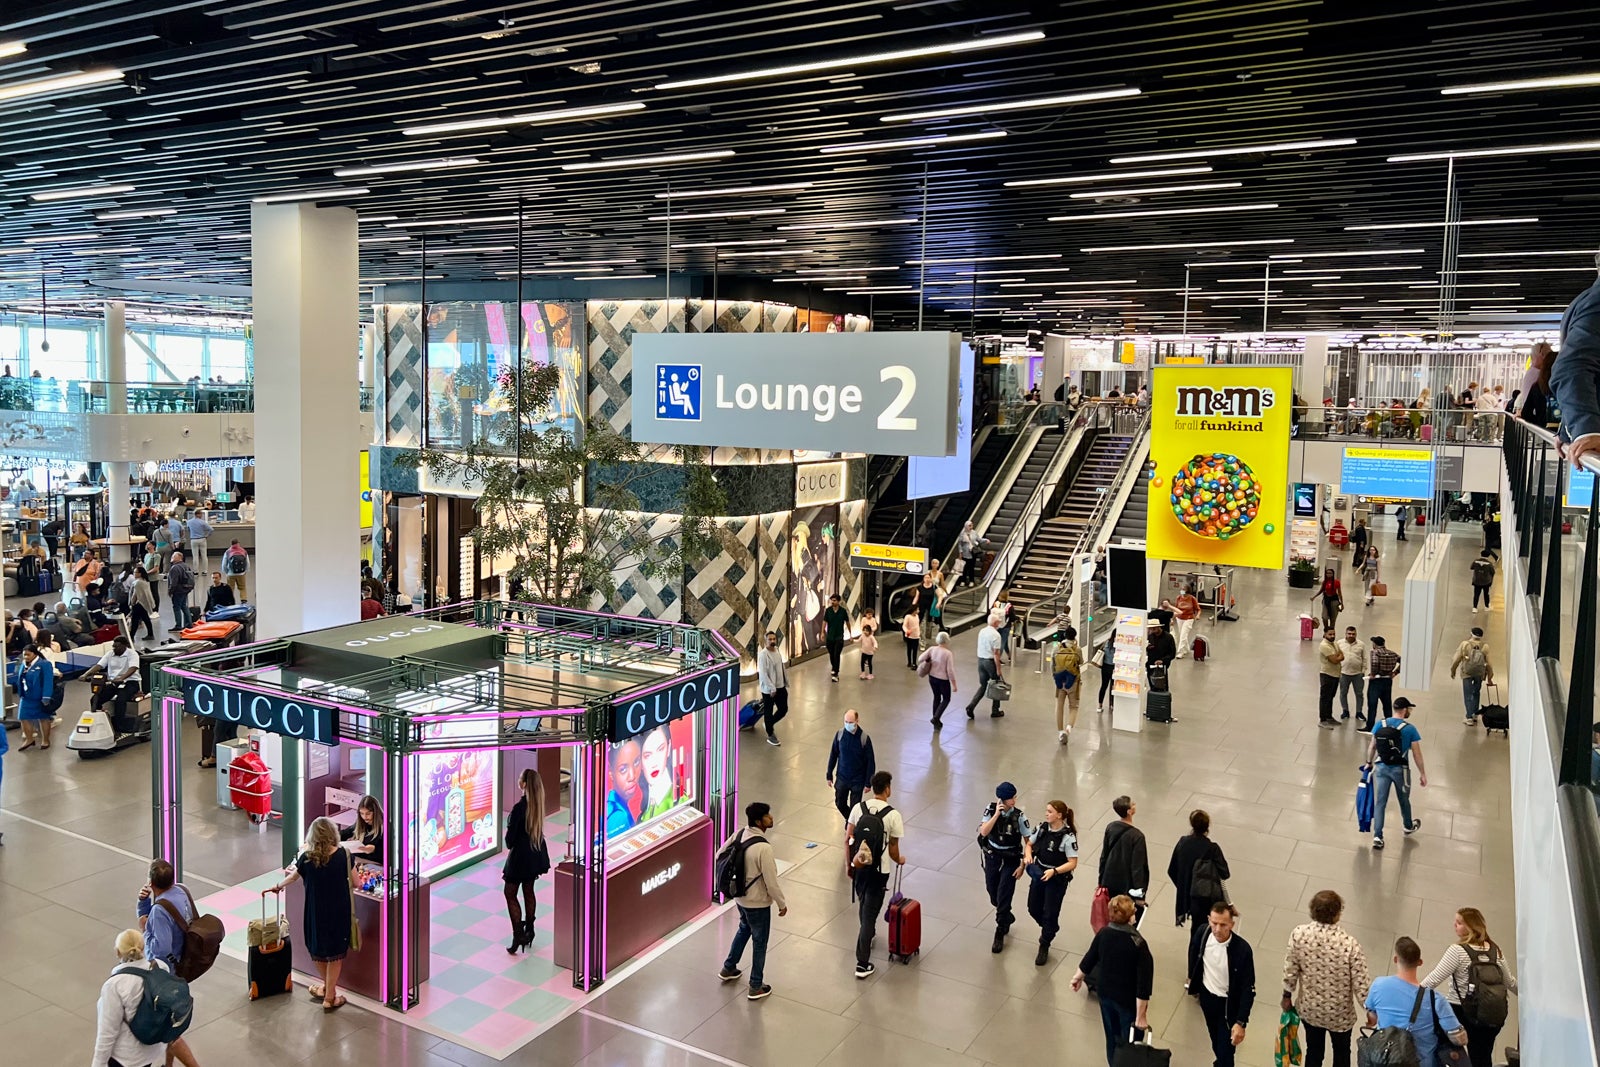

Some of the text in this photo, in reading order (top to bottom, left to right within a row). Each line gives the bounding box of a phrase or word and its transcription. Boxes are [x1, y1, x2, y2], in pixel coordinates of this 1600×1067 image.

[716, 365, 918, 431] Lounge 2
[1174, 419, 1264, 432] for all funkind
[160, 460, 219, 472] AMSTERDAM
[798, 472, 841, 492] GUCCI
[885, 549, 892, 557] D
[345, 624, 444, 647] GUCCI
[193, 683, 320, 741] GUCCI
[625, 668, 733, 734] GUCCI
[641, 862, 681, 895] MAKE-UP
